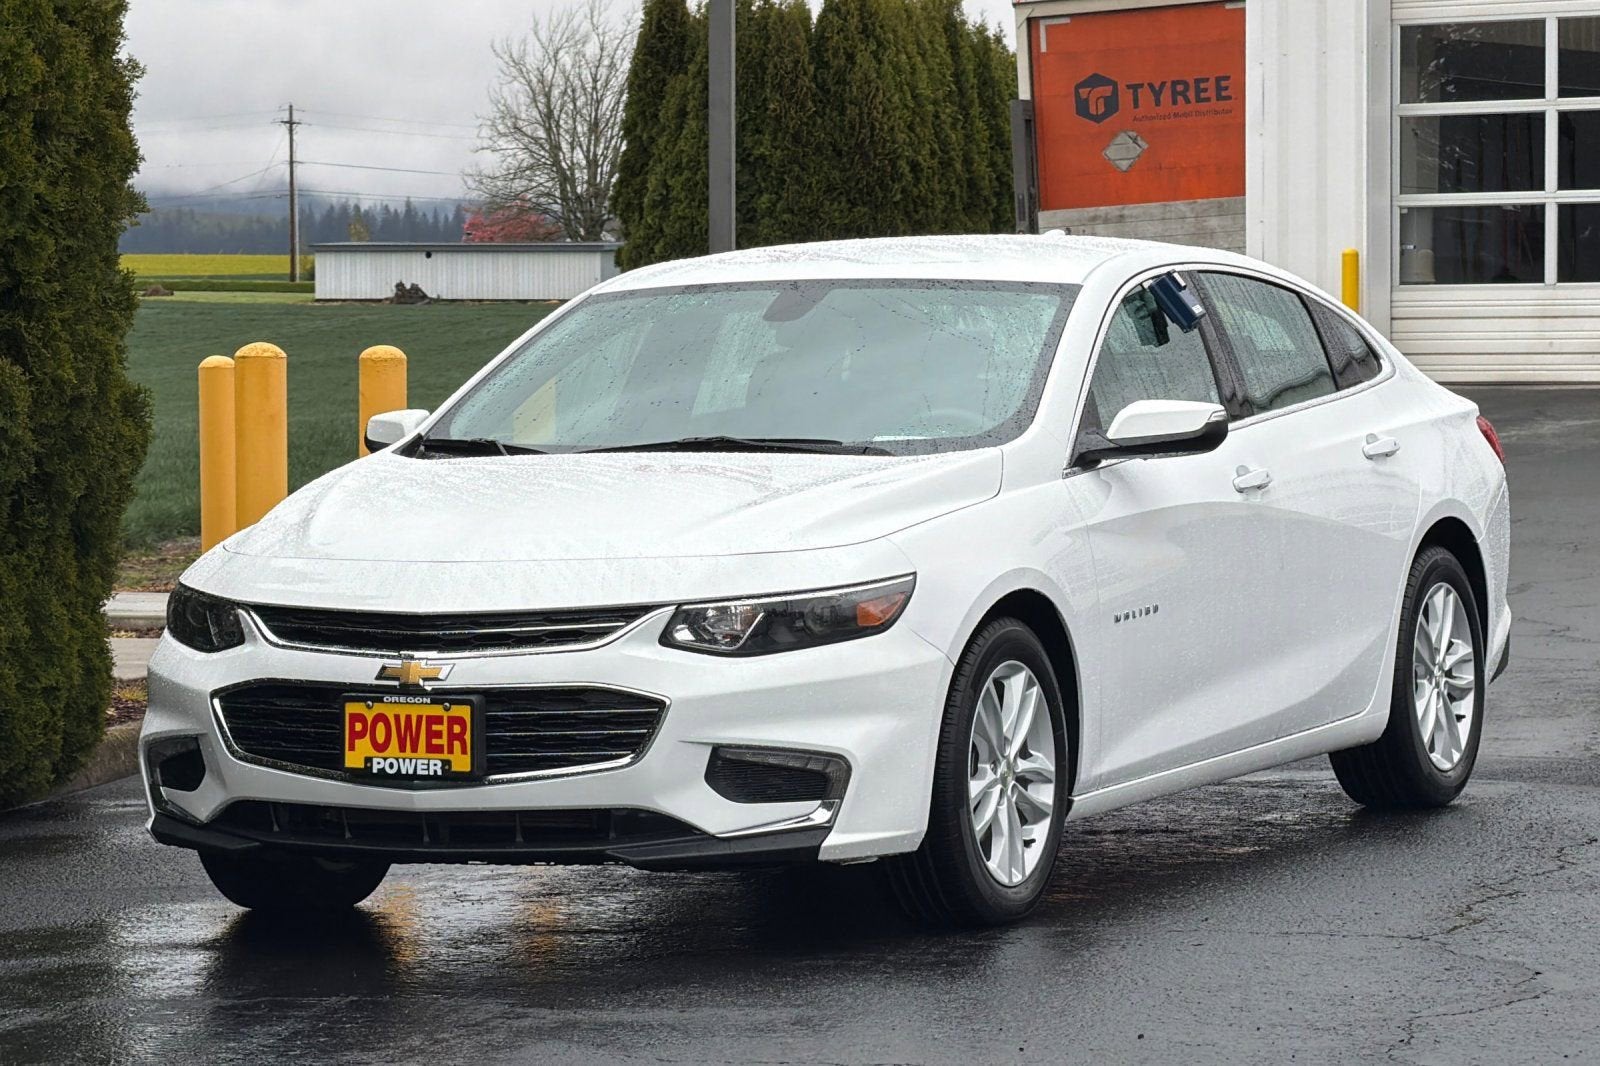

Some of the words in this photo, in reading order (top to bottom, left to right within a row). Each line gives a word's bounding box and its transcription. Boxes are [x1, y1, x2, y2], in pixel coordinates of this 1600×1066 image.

[1126, 75, 1233, 110] TYREE
[383, 696, 431, 704] OREGON
[347, 712, 468, 755] POWER
[372, 757, 442, 776] POWER
